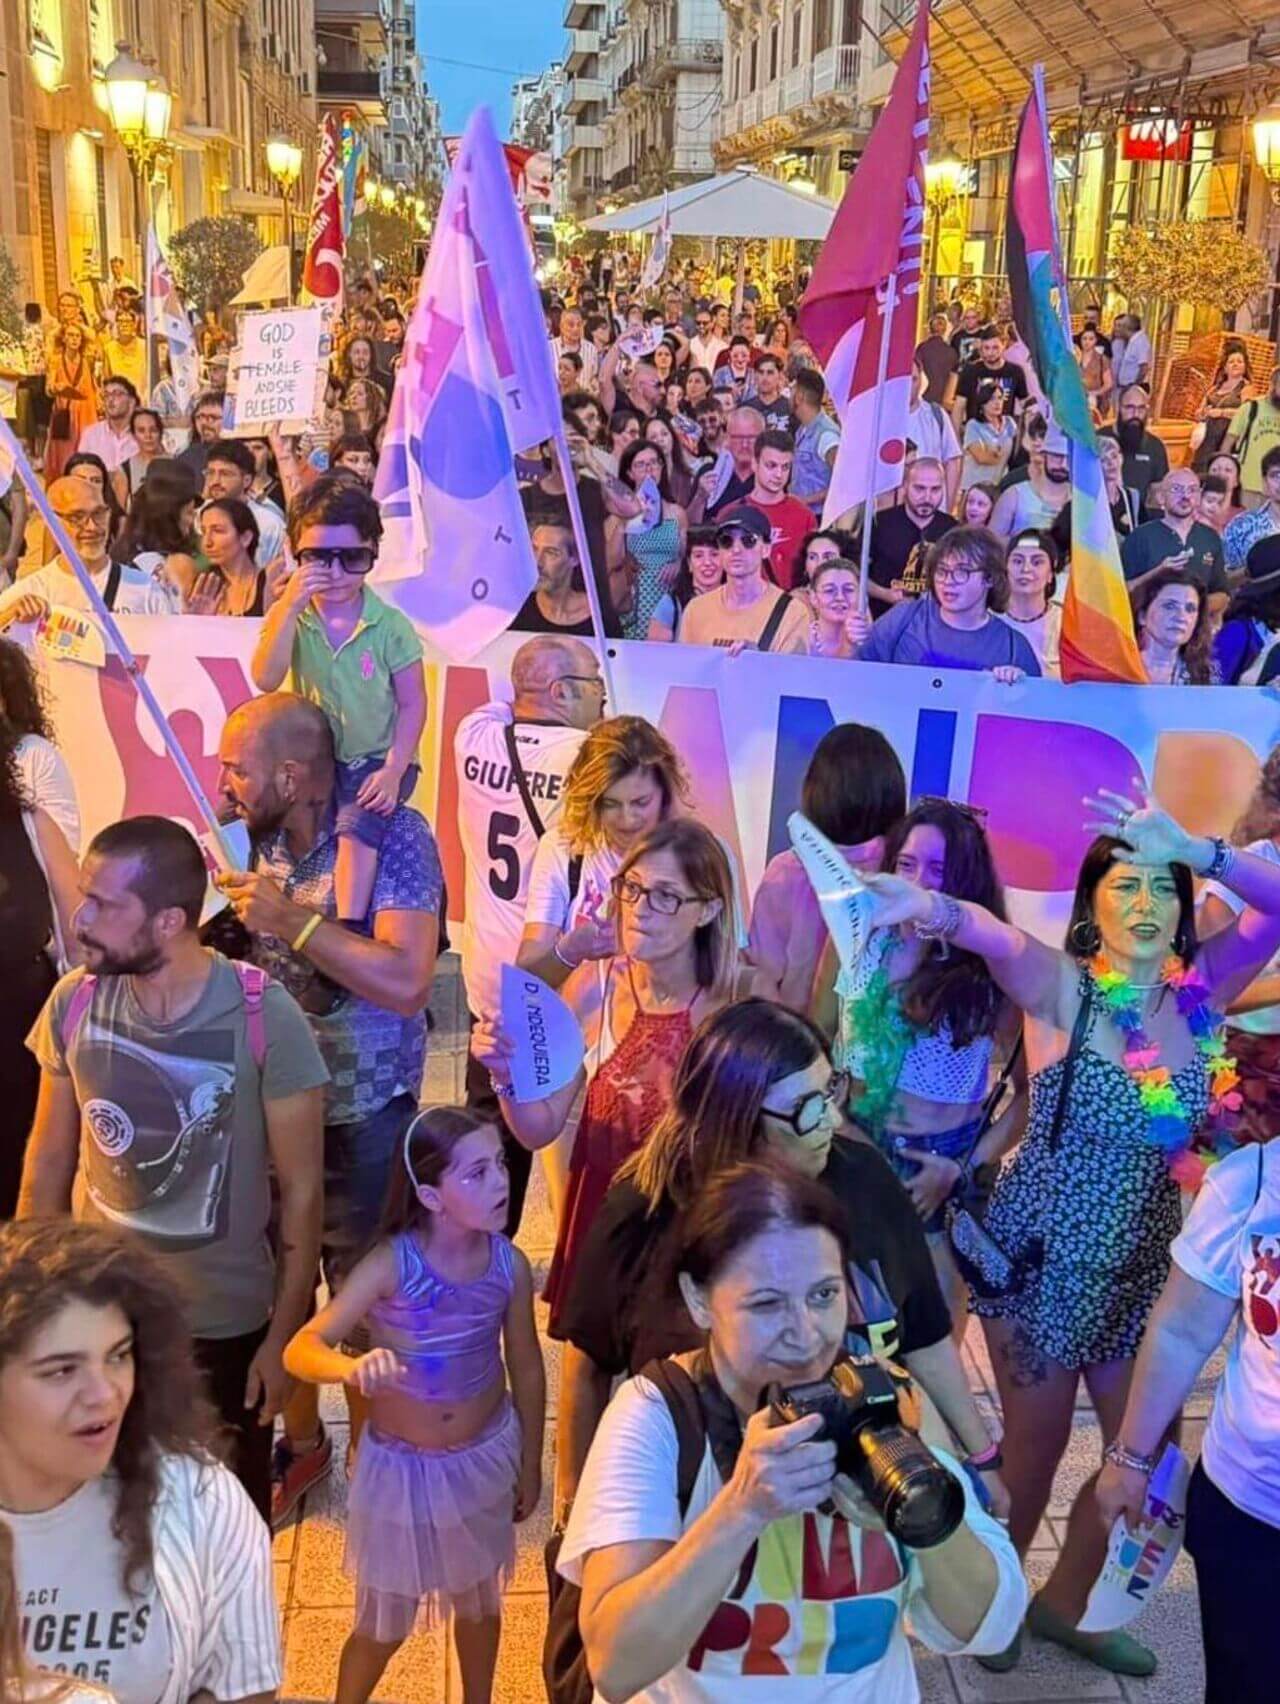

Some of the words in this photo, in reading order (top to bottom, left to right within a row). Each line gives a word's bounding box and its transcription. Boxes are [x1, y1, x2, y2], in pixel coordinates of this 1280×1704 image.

[259, 322, 295, 344] GOD
[271, 348, 283, 360] IS
[244, 397, 296, 419] BLEEDS
[487, 810, 521, 902] 5
[524, 982, 551, 1087] DNDEQUIERA
